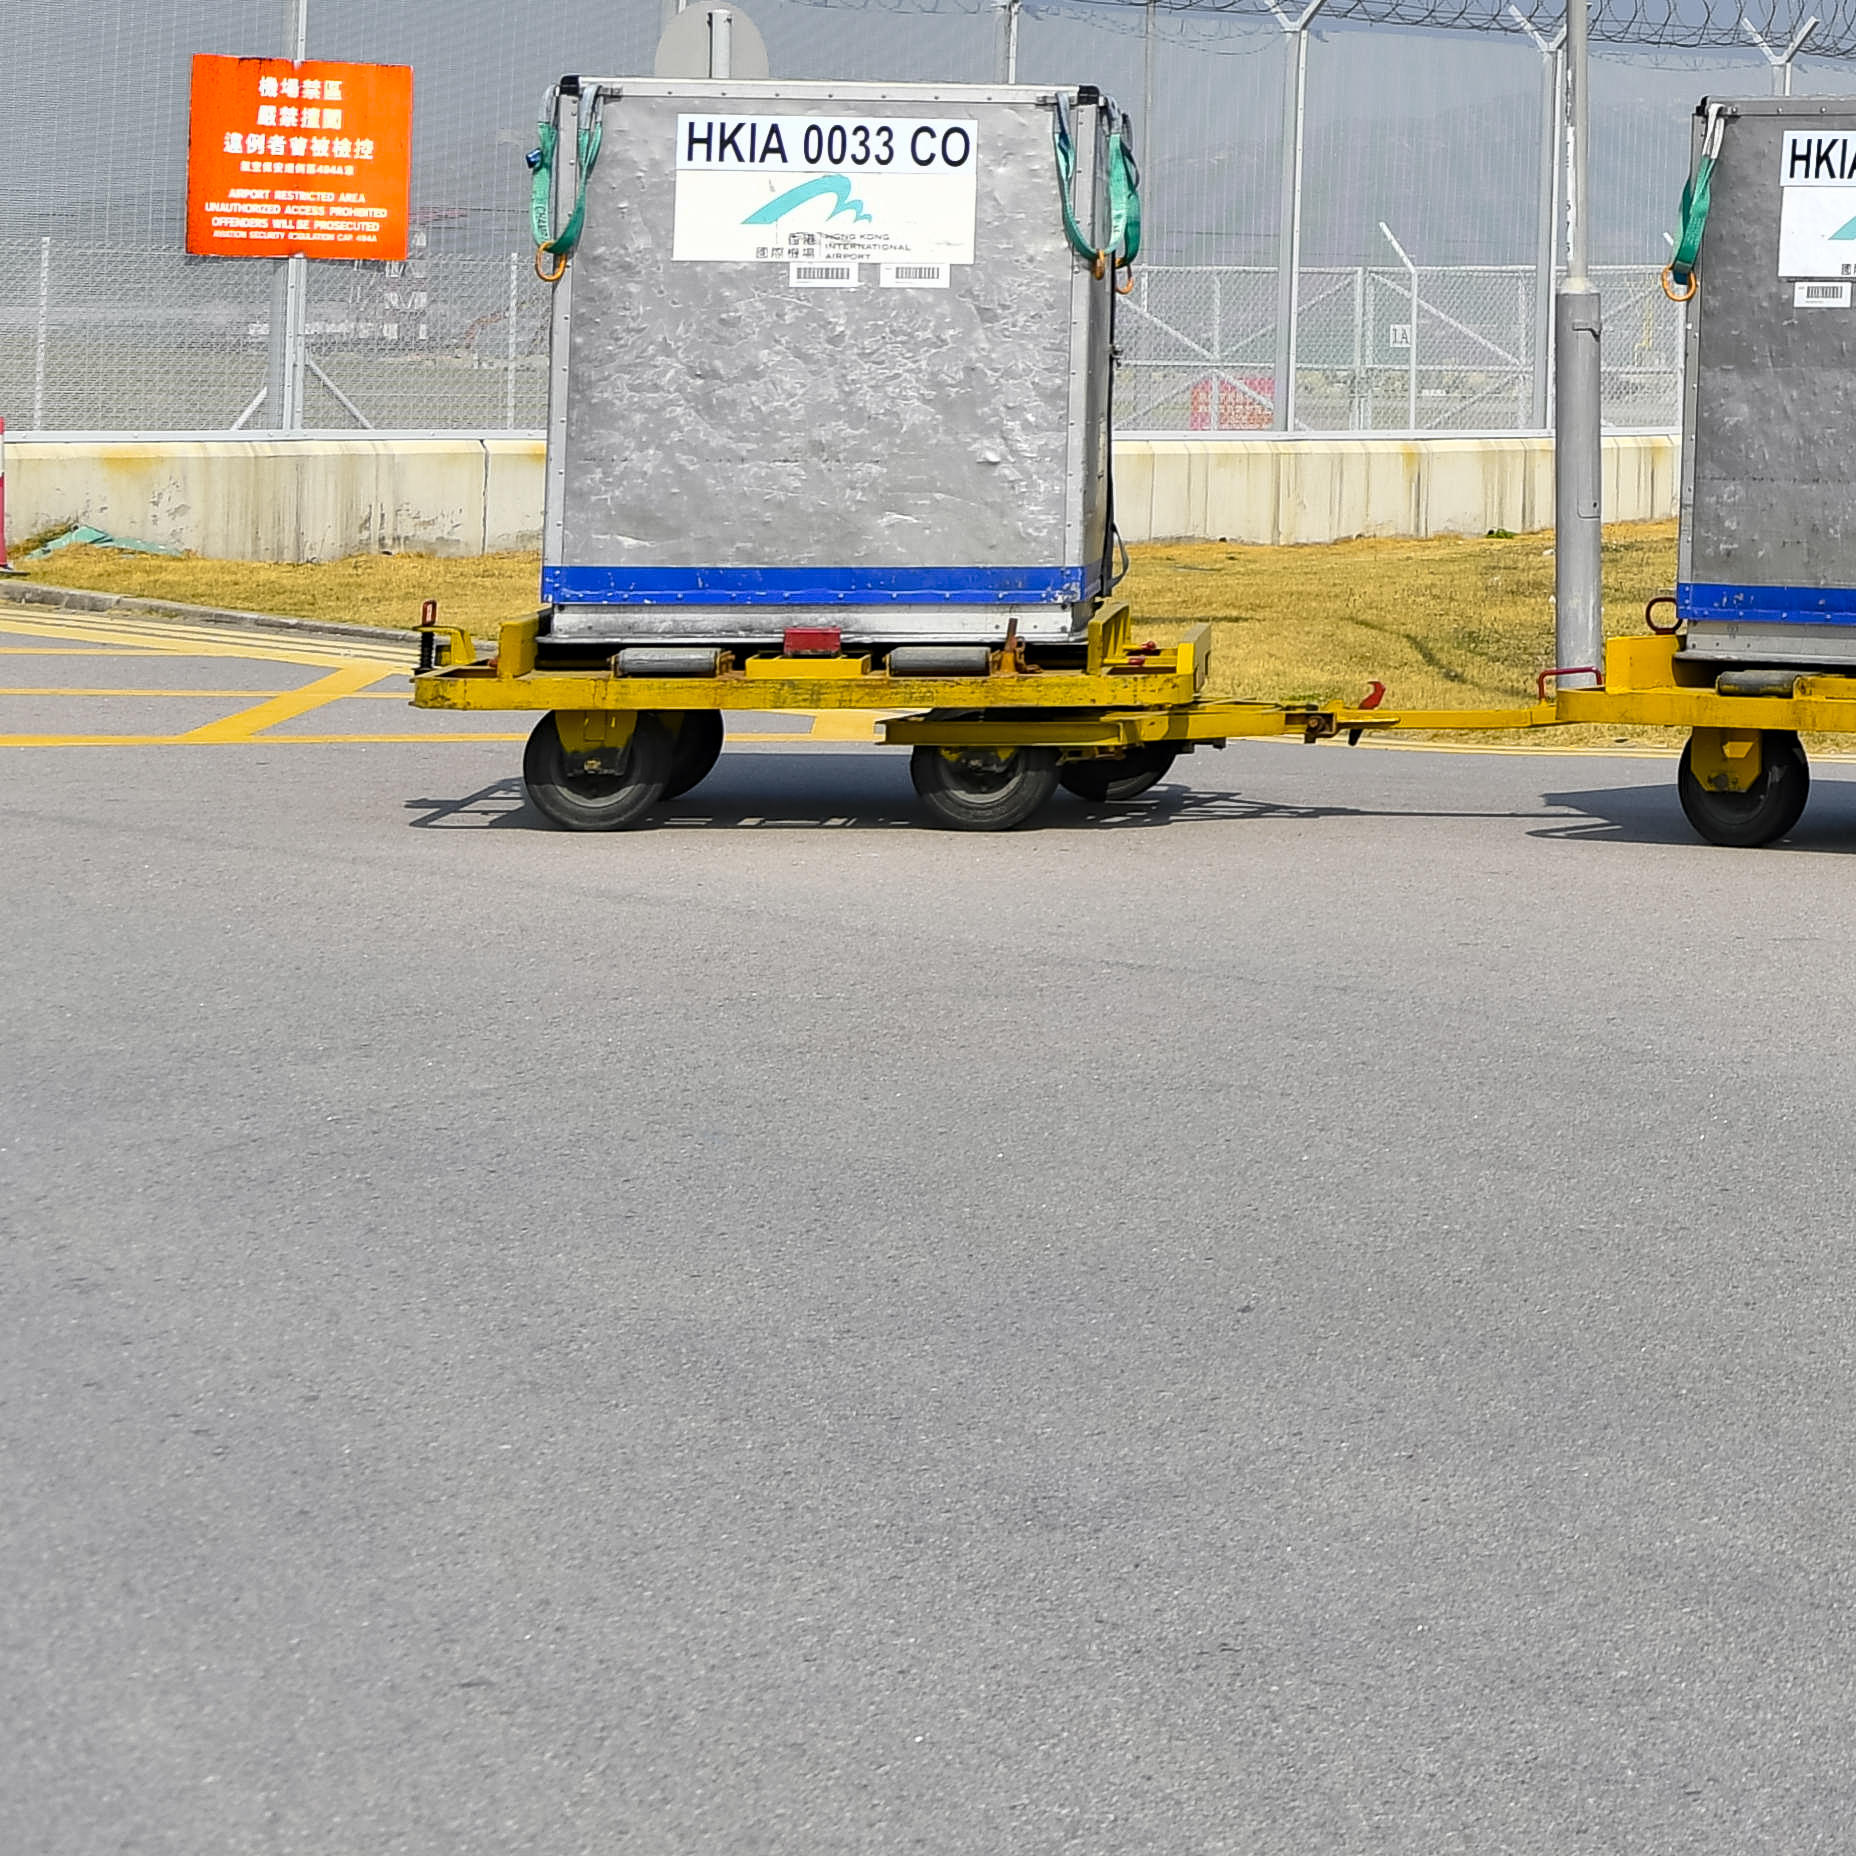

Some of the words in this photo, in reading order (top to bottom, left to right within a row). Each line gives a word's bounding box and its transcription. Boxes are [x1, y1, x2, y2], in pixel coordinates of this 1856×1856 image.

[686, 121, 788, 164] HKIA
[803, 124, 895, 166] 0033
[910, 125, 970, 167] CO
[228, 188, 270, 199] AIRPORT
[274, 190, 335, 202] RESTRICTED
[338, 192, 366, 203] AREA
[205, 202, 281, 214] UNAUTHORIZED
[284, 205, 325, 216] ACCESS
[329, 206, 387, 218] PROHIBITED
[212, 216, 268, 228] OFFENDERS
[272, 218, 295, 229] WILL
[296, 219, 310, 230] BE
[314, 220, 379, 232] PROSECUTED
[825, 243, 911, 251] INTERNATIONAL
